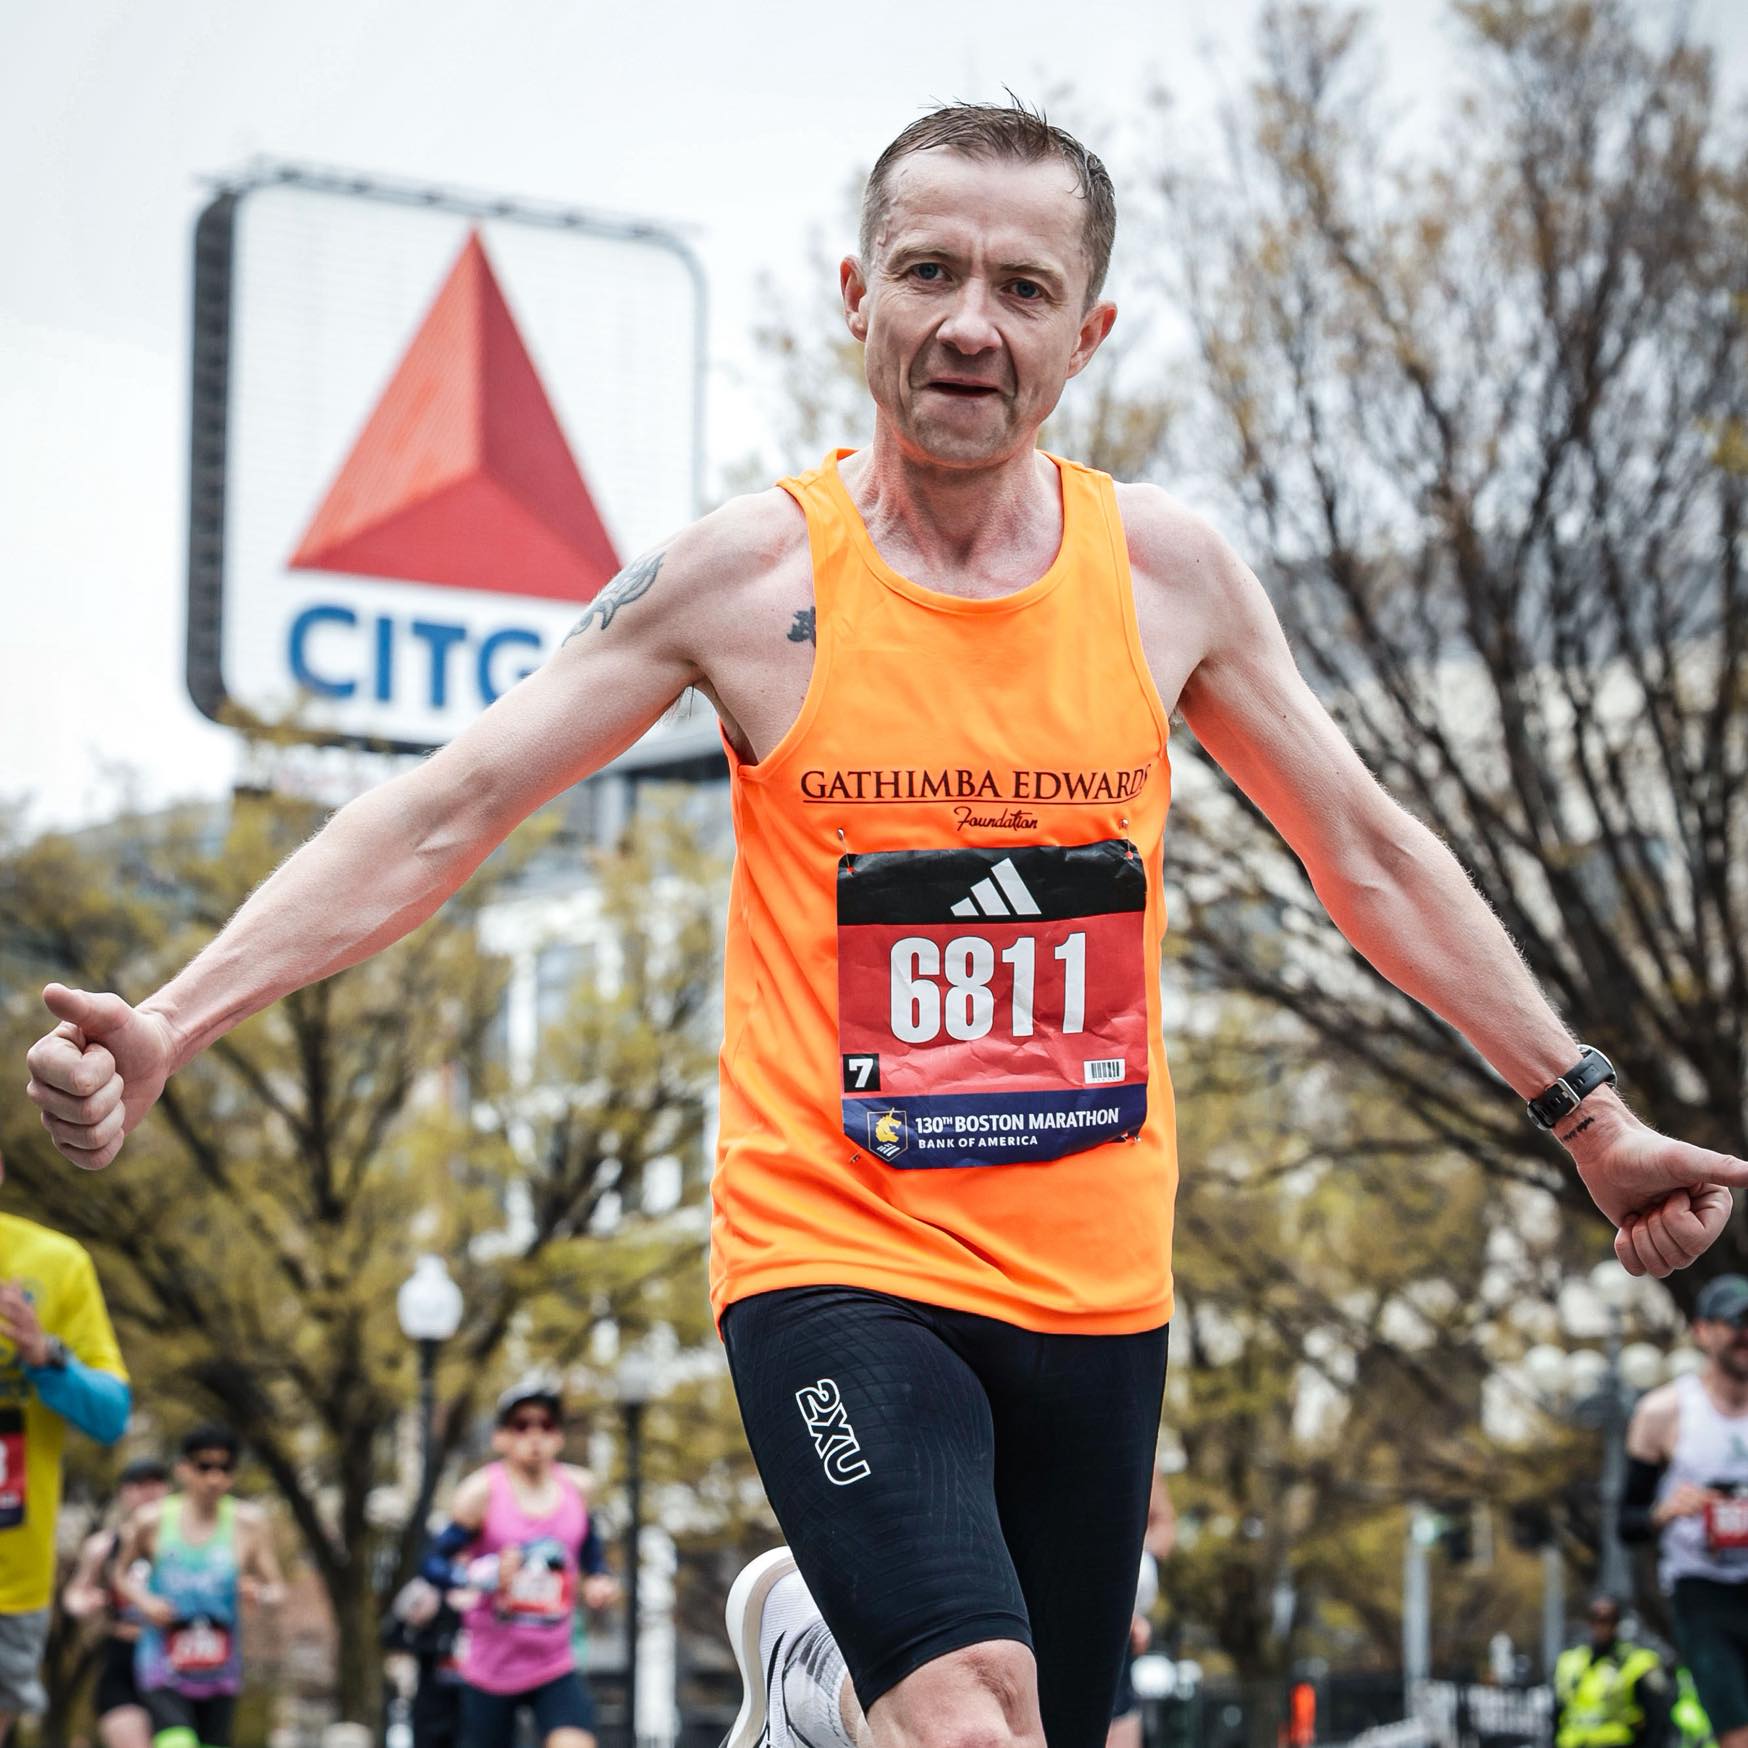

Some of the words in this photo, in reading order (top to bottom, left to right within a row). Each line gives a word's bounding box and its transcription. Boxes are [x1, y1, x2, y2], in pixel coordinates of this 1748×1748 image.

[288, 605, 541, 708] CITG
[800, 769, 1001, 799] GATHIMBA
[954, 806, 1038, 831] Foundation
[890, 932, 1087, 1044] 6811
[848, 1059, 874, 1088] 7
[915, 1117, 953, 1134] 130TH
[954, 1114, 1024, 1133] BOSTON
[1028, 1107, 1119, 1130] MARATHON
[918, 1138, 955, 1149] BANK
[958, 1137, 976, 1148] OF
[978, 1135, 1038, 1147] AMERICA
[795, 1378, 872, 1486] 2XU
